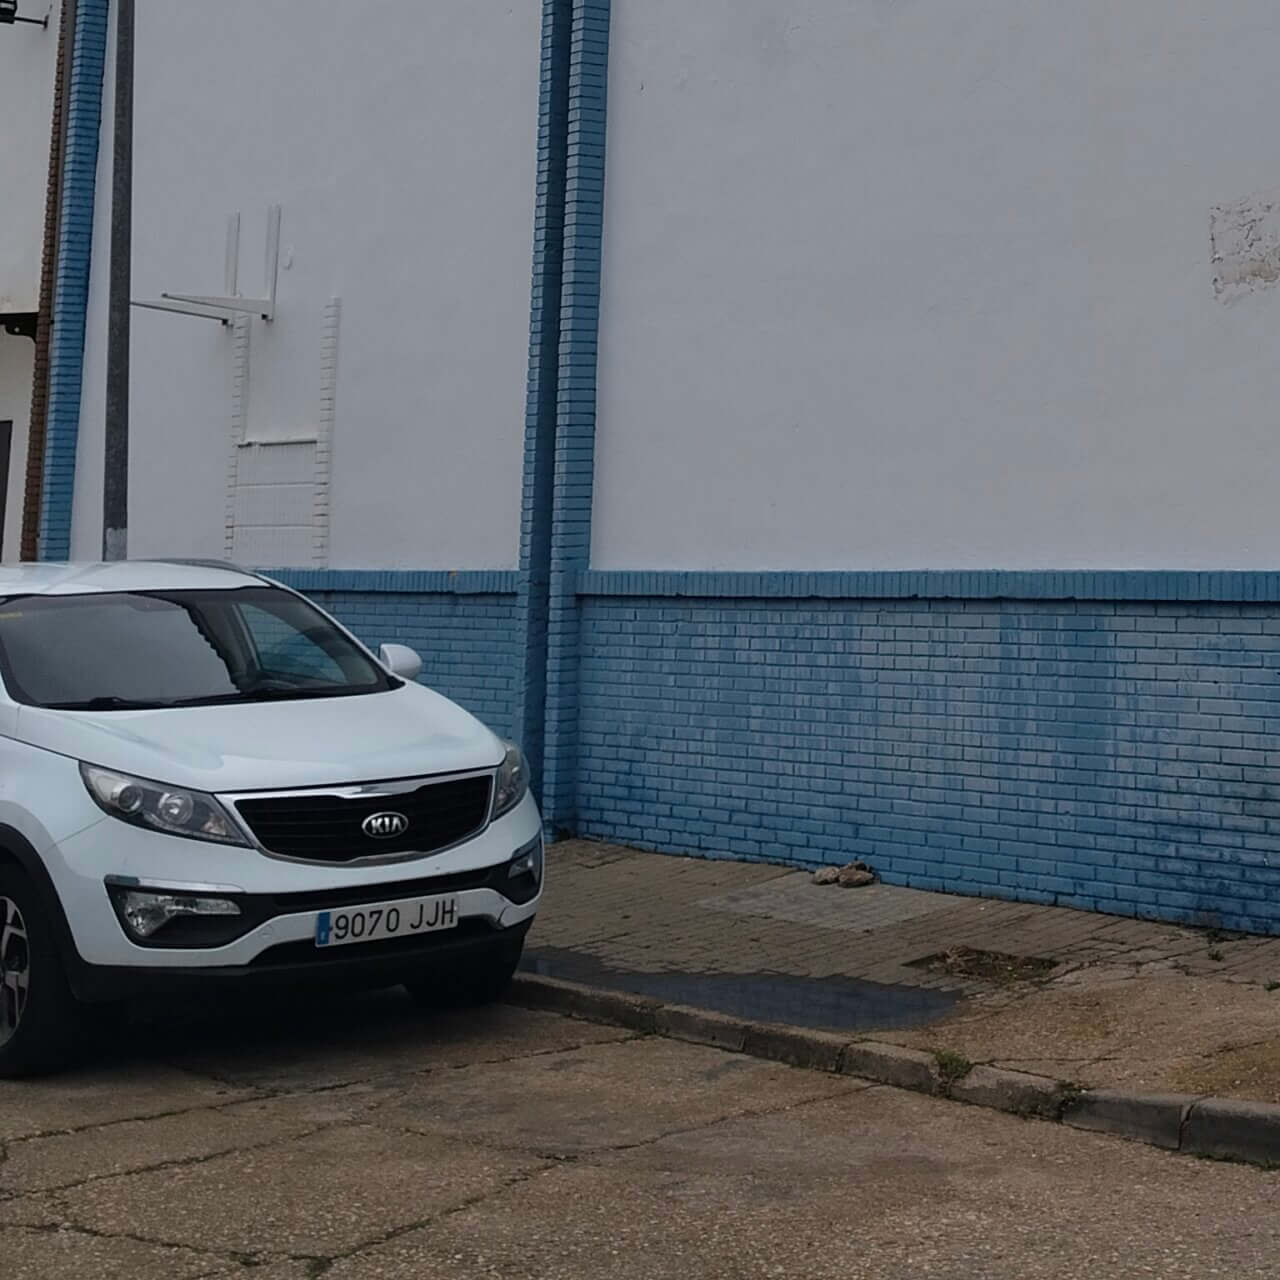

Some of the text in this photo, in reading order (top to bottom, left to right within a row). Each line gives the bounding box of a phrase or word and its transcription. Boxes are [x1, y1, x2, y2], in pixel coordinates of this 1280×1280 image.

[370, 817, 403, 834] KIA
[334, 899, 455, 940] 9070 JJH
